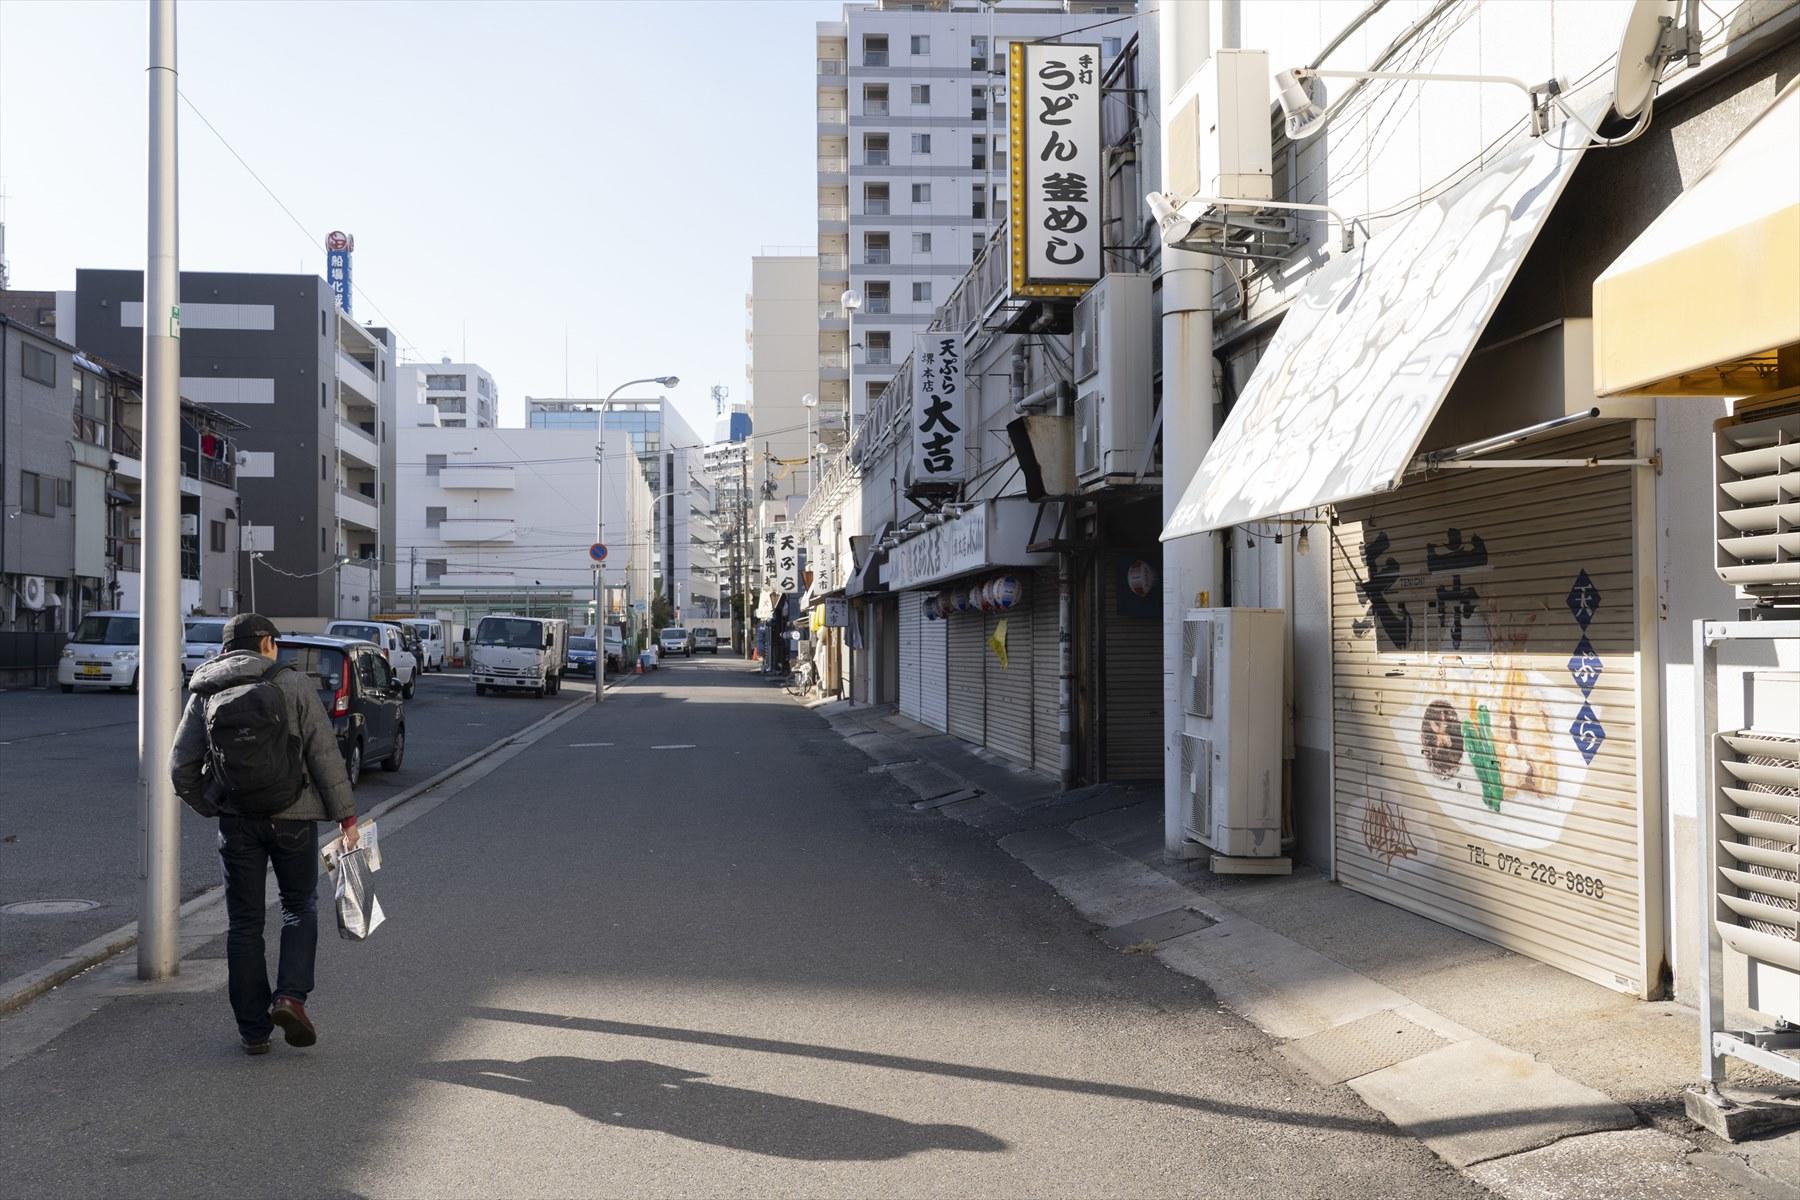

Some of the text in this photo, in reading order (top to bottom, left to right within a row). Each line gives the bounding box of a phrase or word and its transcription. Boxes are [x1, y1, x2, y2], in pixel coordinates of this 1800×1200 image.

[1078, 54, 1094, 85] 手打
[1039, 60, 1089, 265] うどん 釜めし
[938, 338, 959, 395] 天ぷら
[919, 394, 961, 474] 大吉
[1573, 584, 1603, 751] 天ぷら
[1466, 844, 1490, 867] TEL
